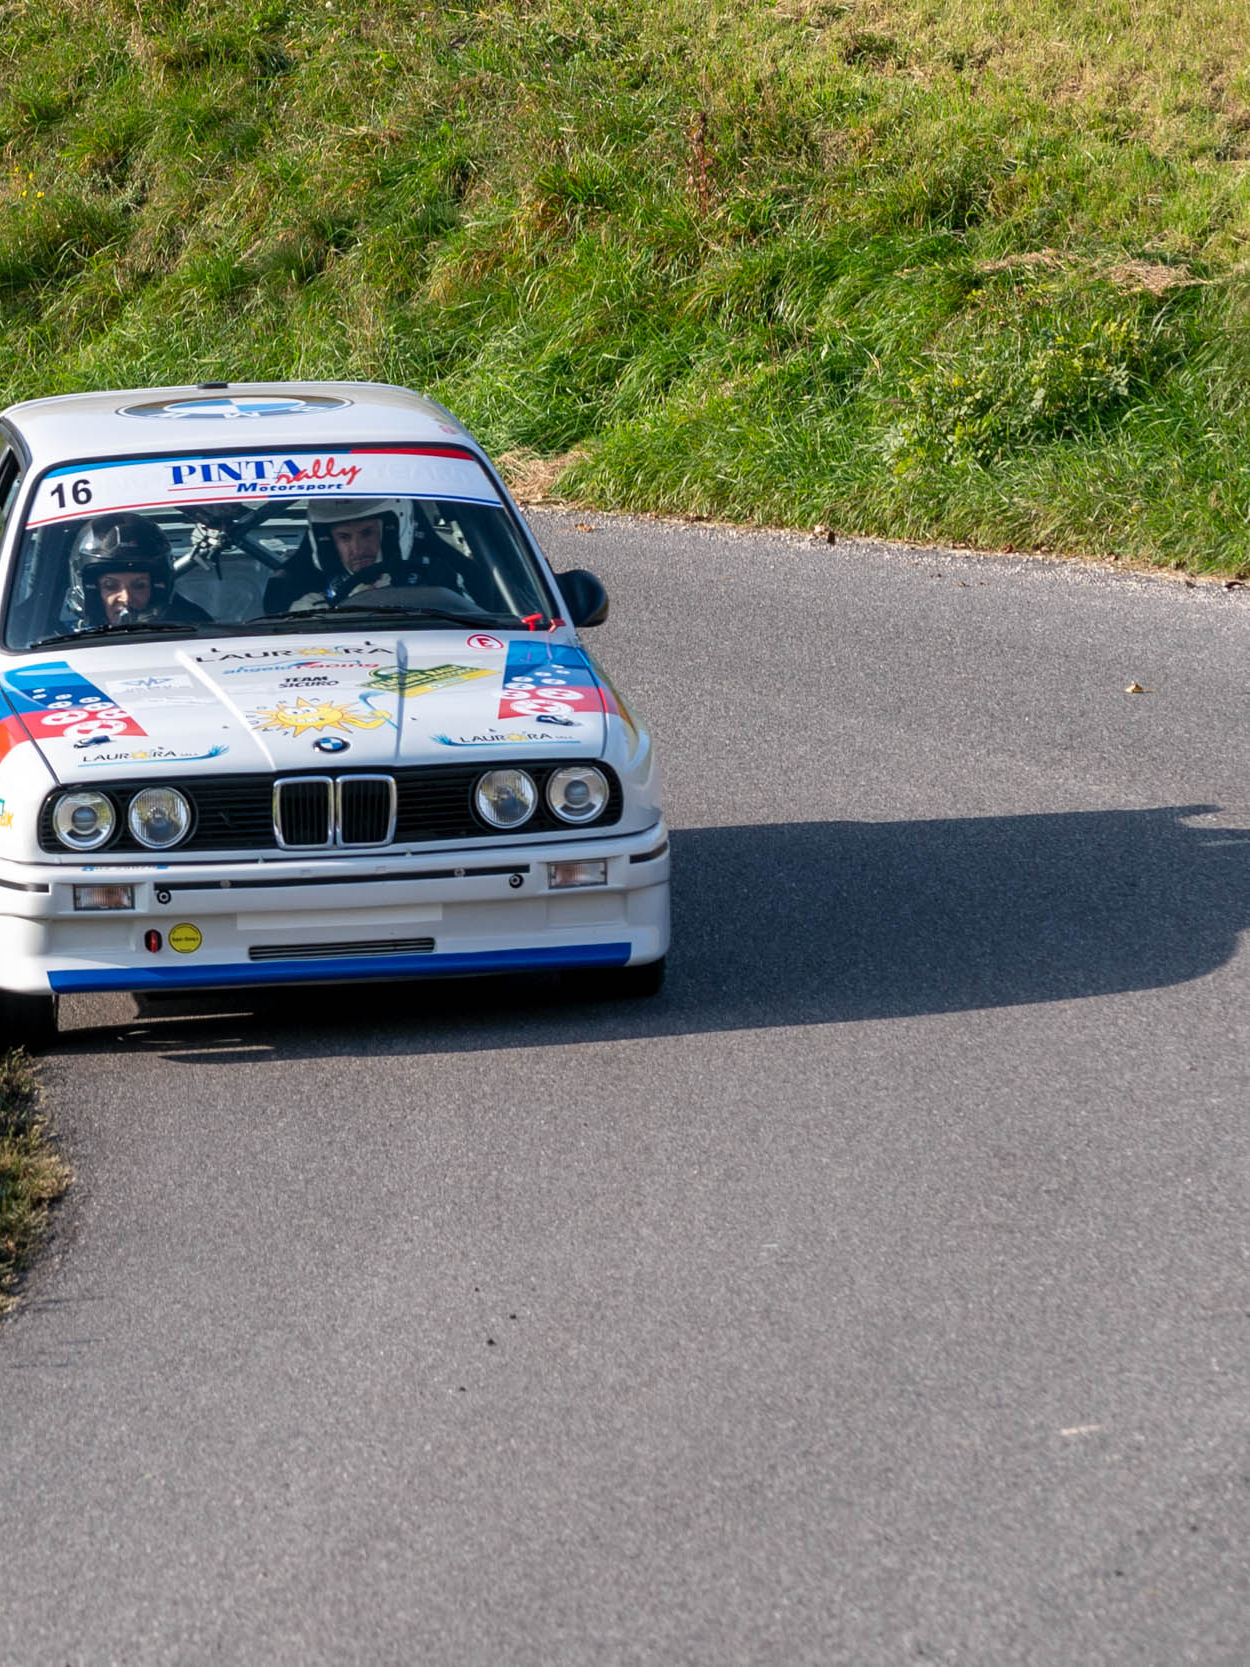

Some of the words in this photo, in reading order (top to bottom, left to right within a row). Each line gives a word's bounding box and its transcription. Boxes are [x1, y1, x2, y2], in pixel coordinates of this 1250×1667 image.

[165, 458, 303, 485] PINTA
[275, 457, 362, 485] rally
[51, 479, 93, 508] 16
[236, 481, 343, 493] Motorsport
[278, 680, 340, 688] SICURO
